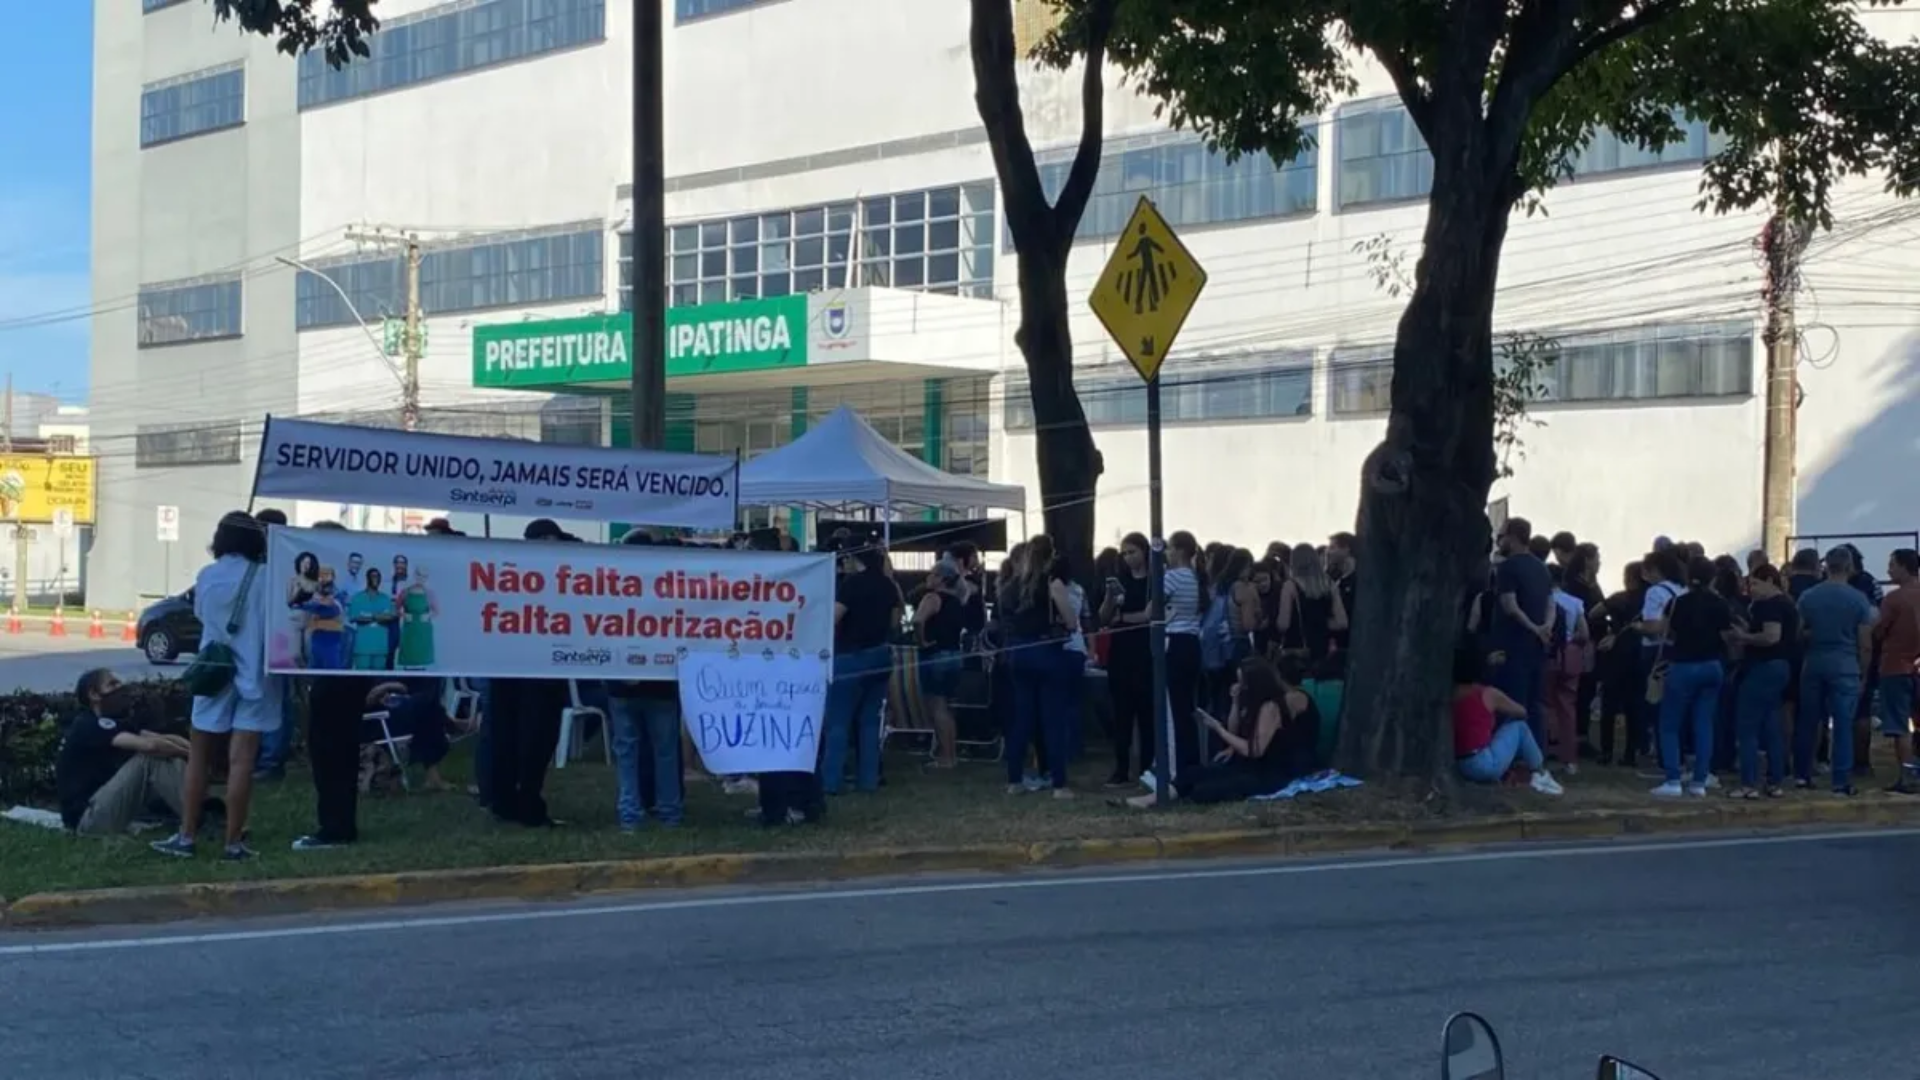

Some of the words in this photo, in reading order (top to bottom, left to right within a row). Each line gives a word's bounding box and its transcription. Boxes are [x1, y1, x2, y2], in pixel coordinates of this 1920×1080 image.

[485, 333, 627, 371] PREFEITURA
[669, 315, 790, 358] IPATINGA
[276, 443, 398, 475] SERVIDOR
[406, 453, 485, 483] UNIDO,
[489, 461, 570, 488] JAMAIS
[576, 463, 630, 491] SERÁ
[636, 471, 729, 498] VENCIDO.
[469, 561, 545, 594] Não
[556, 564, 642, 597] falta
[653, 570, 806, 608] dinheiro,
[481, 603, 571, 635] falta
[584, 608, 795, 645] valorização!
[696, 664, 768, 702] Quem
[698, 711, 816, 753] BUZINA
